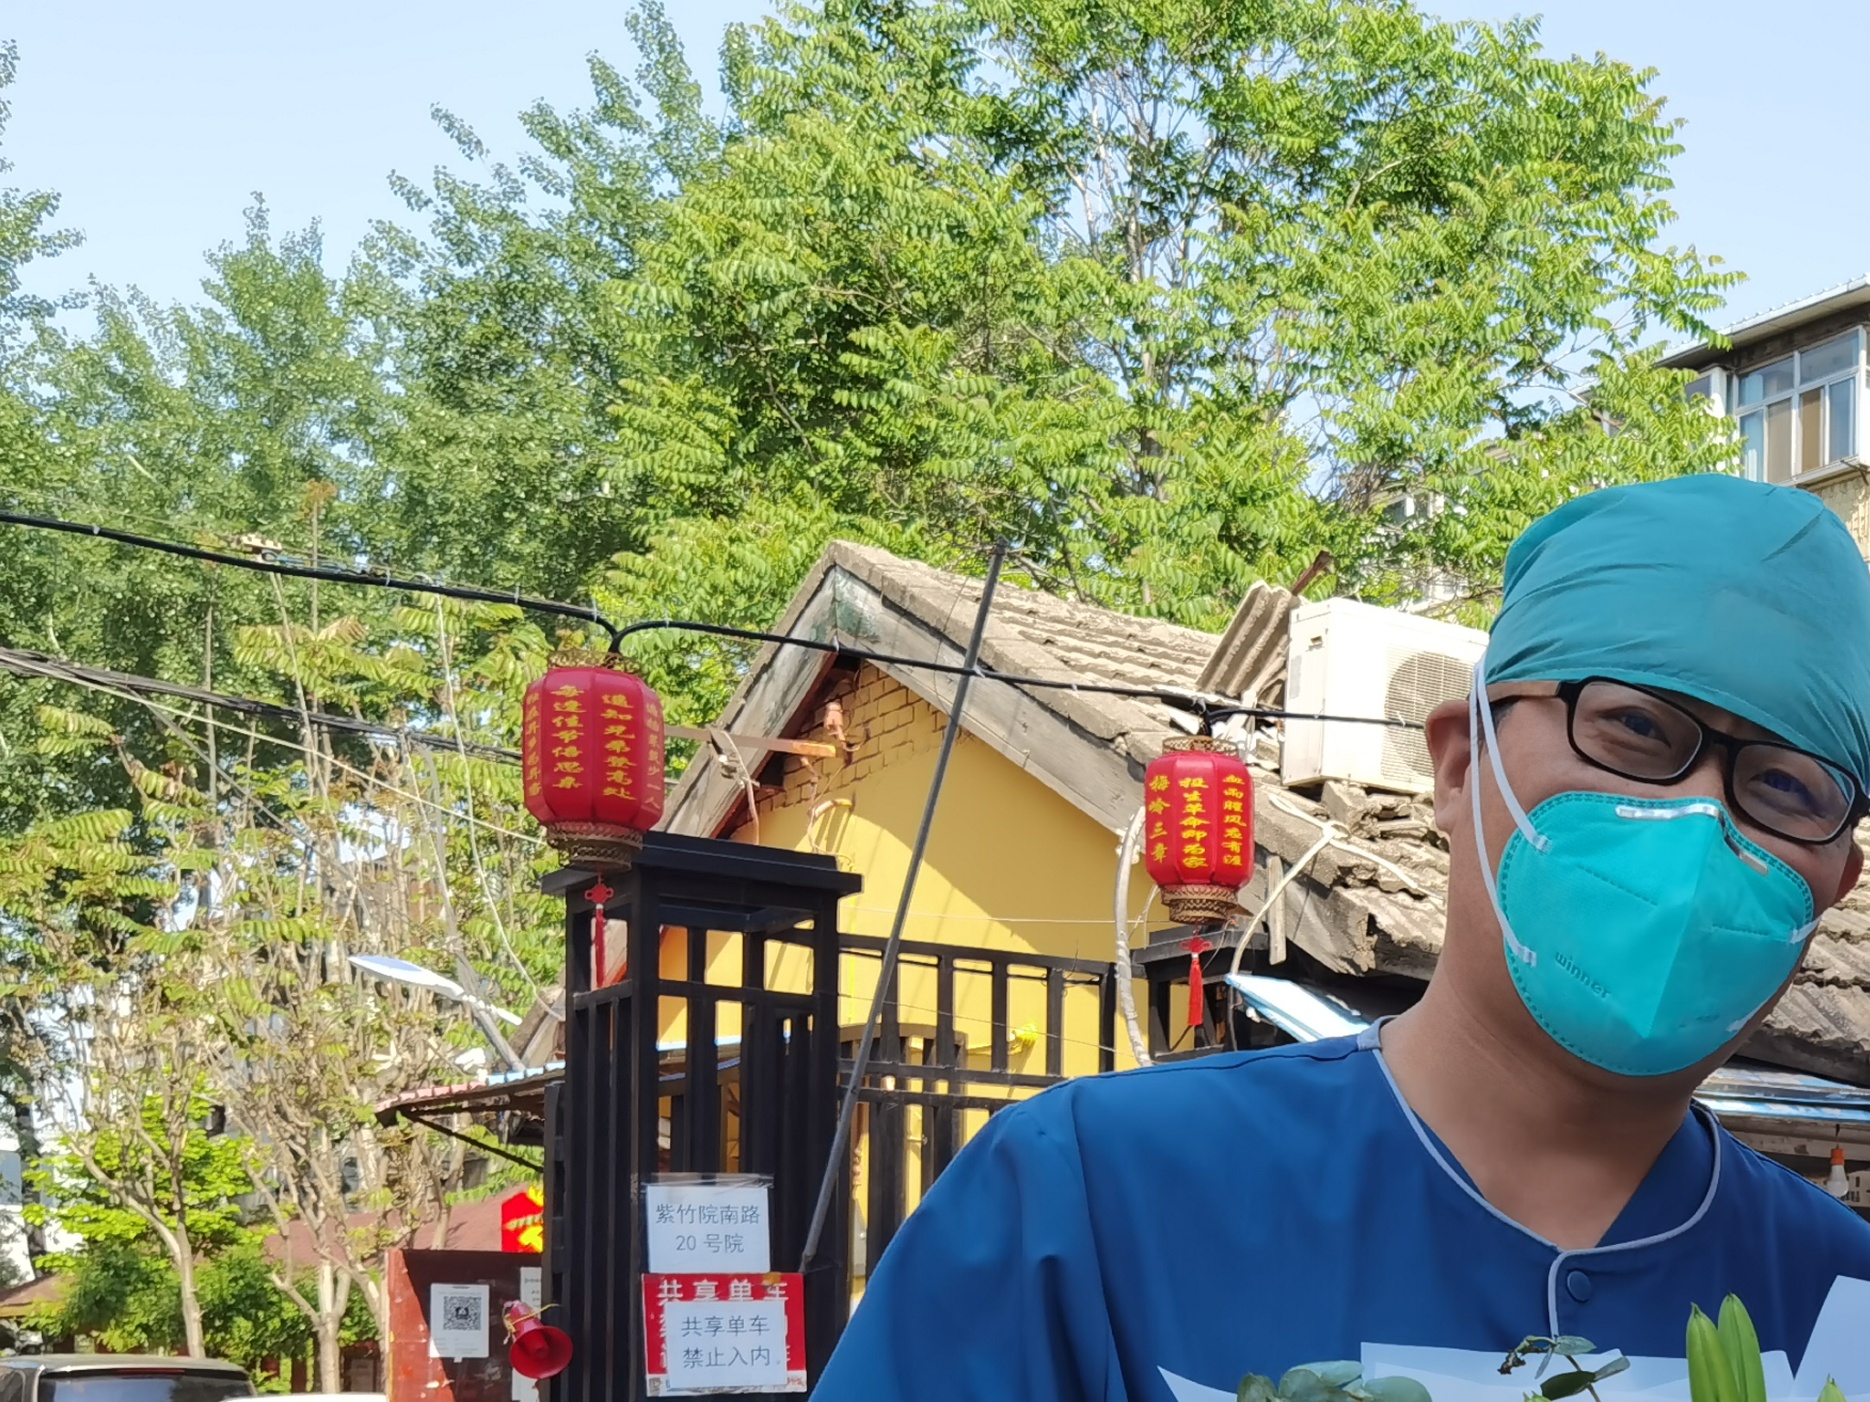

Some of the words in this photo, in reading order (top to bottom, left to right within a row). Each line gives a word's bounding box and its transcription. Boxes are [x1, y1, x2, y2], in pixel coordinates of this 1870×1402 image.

[1554, 952, 1611, 998] winner
[655, 1203, 760, 1224] 紫竹院南路
[675, 1234, 697, 1251] 20
[703, 1233, 745, 1253] 号院
[680, 1314, 771, 1338] 共享单车
